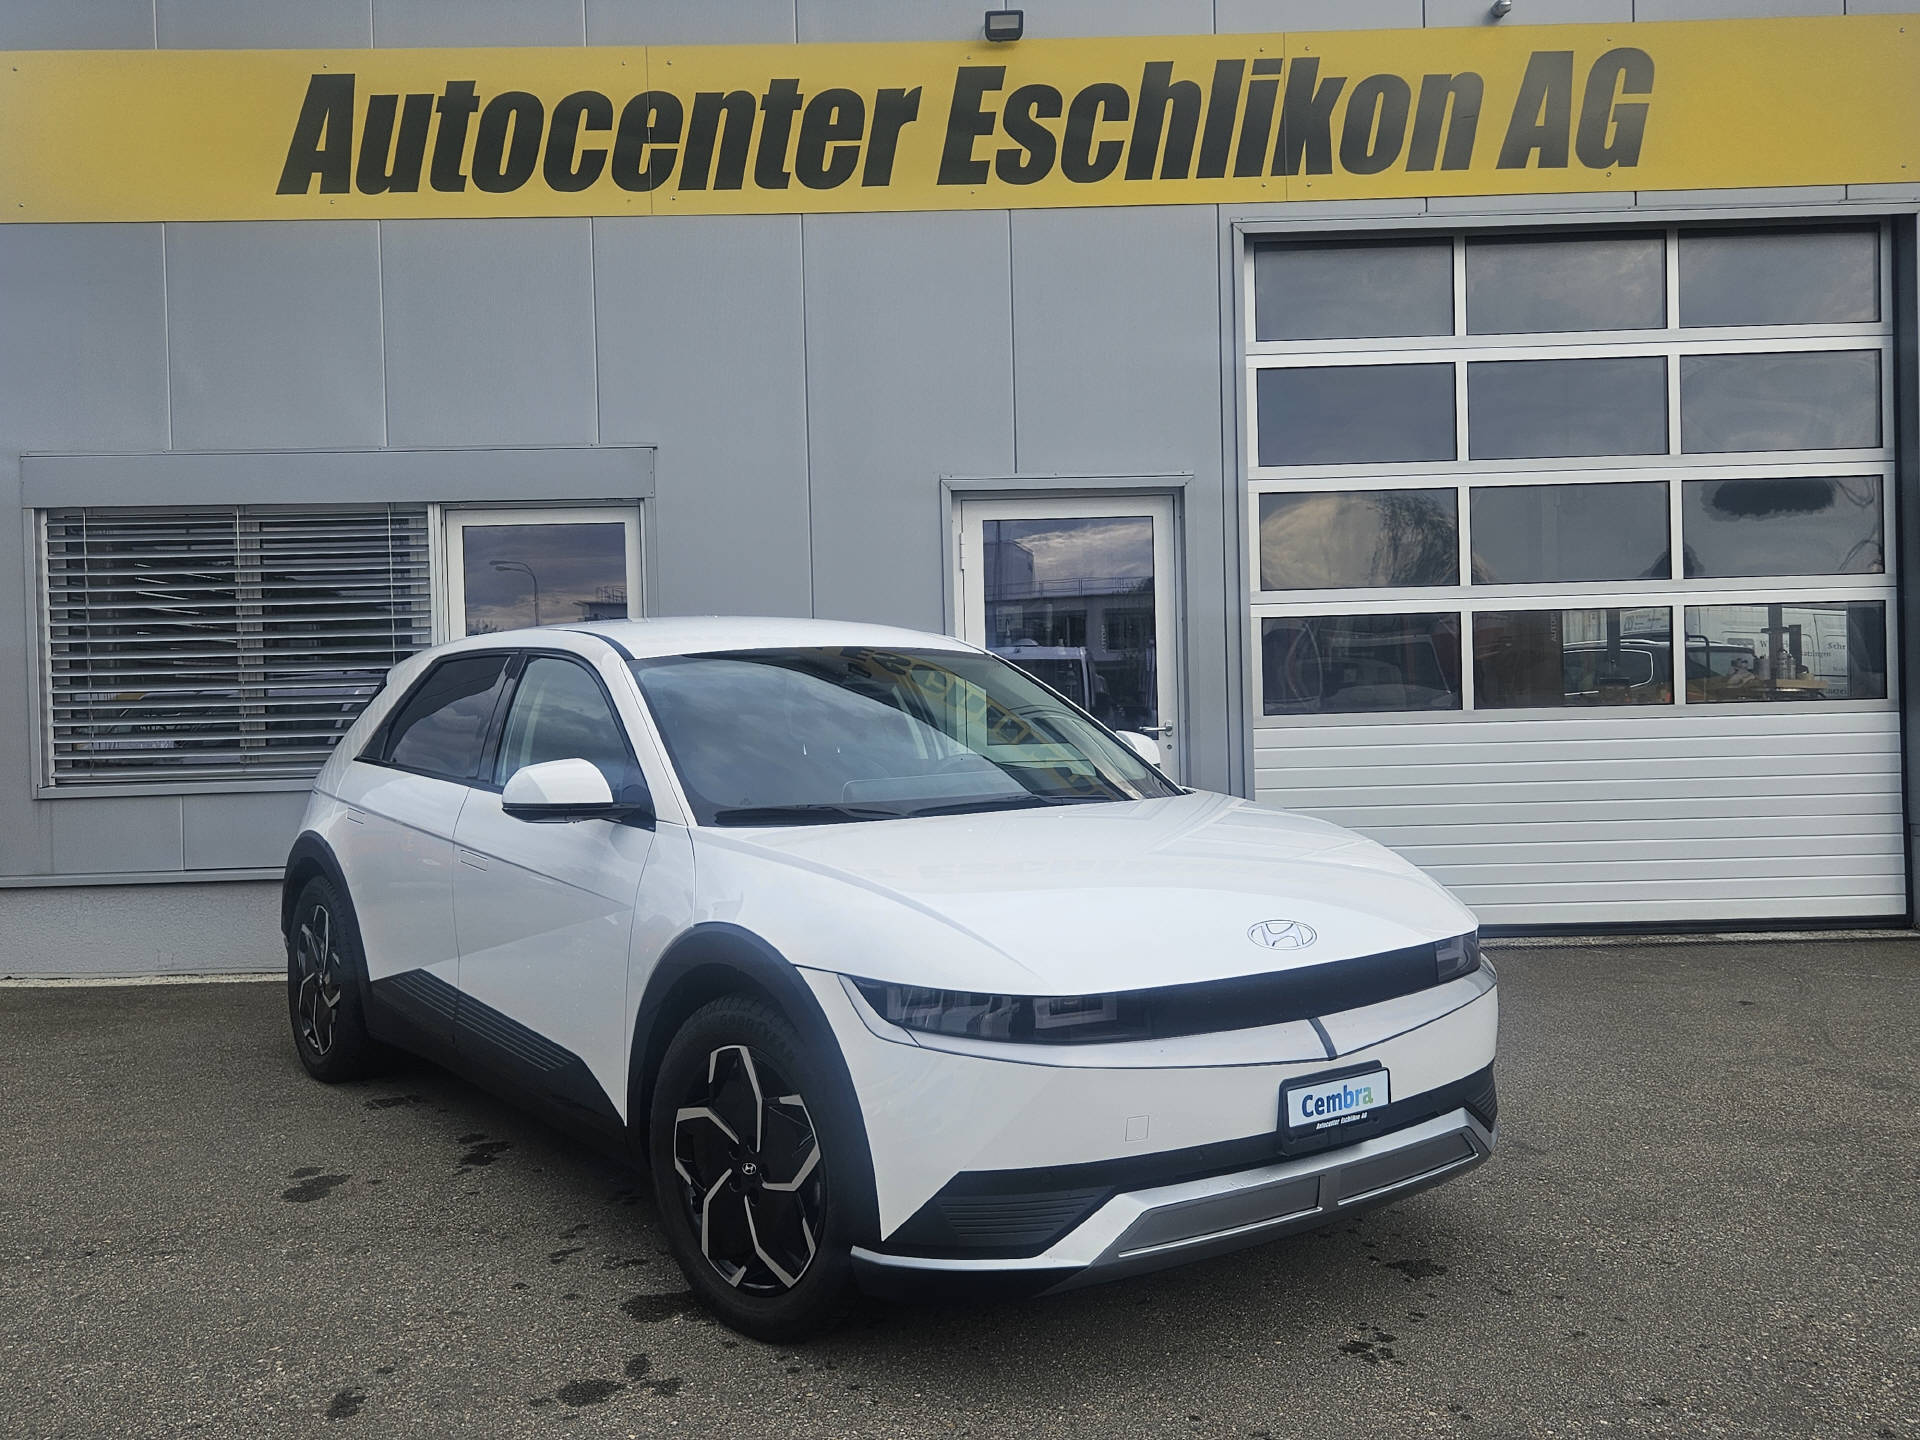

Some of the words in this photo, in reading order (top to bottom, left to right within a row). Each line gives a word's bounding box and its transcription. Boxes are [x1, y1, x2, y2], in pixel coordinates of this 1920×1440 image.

[275, 73, 923, 195] Autocenter
[937, 56, 1485, 185] Eschlikon
[1496, 47, 1656, 171] AG
[1302, 1084, 1373, 1117] Cembra
